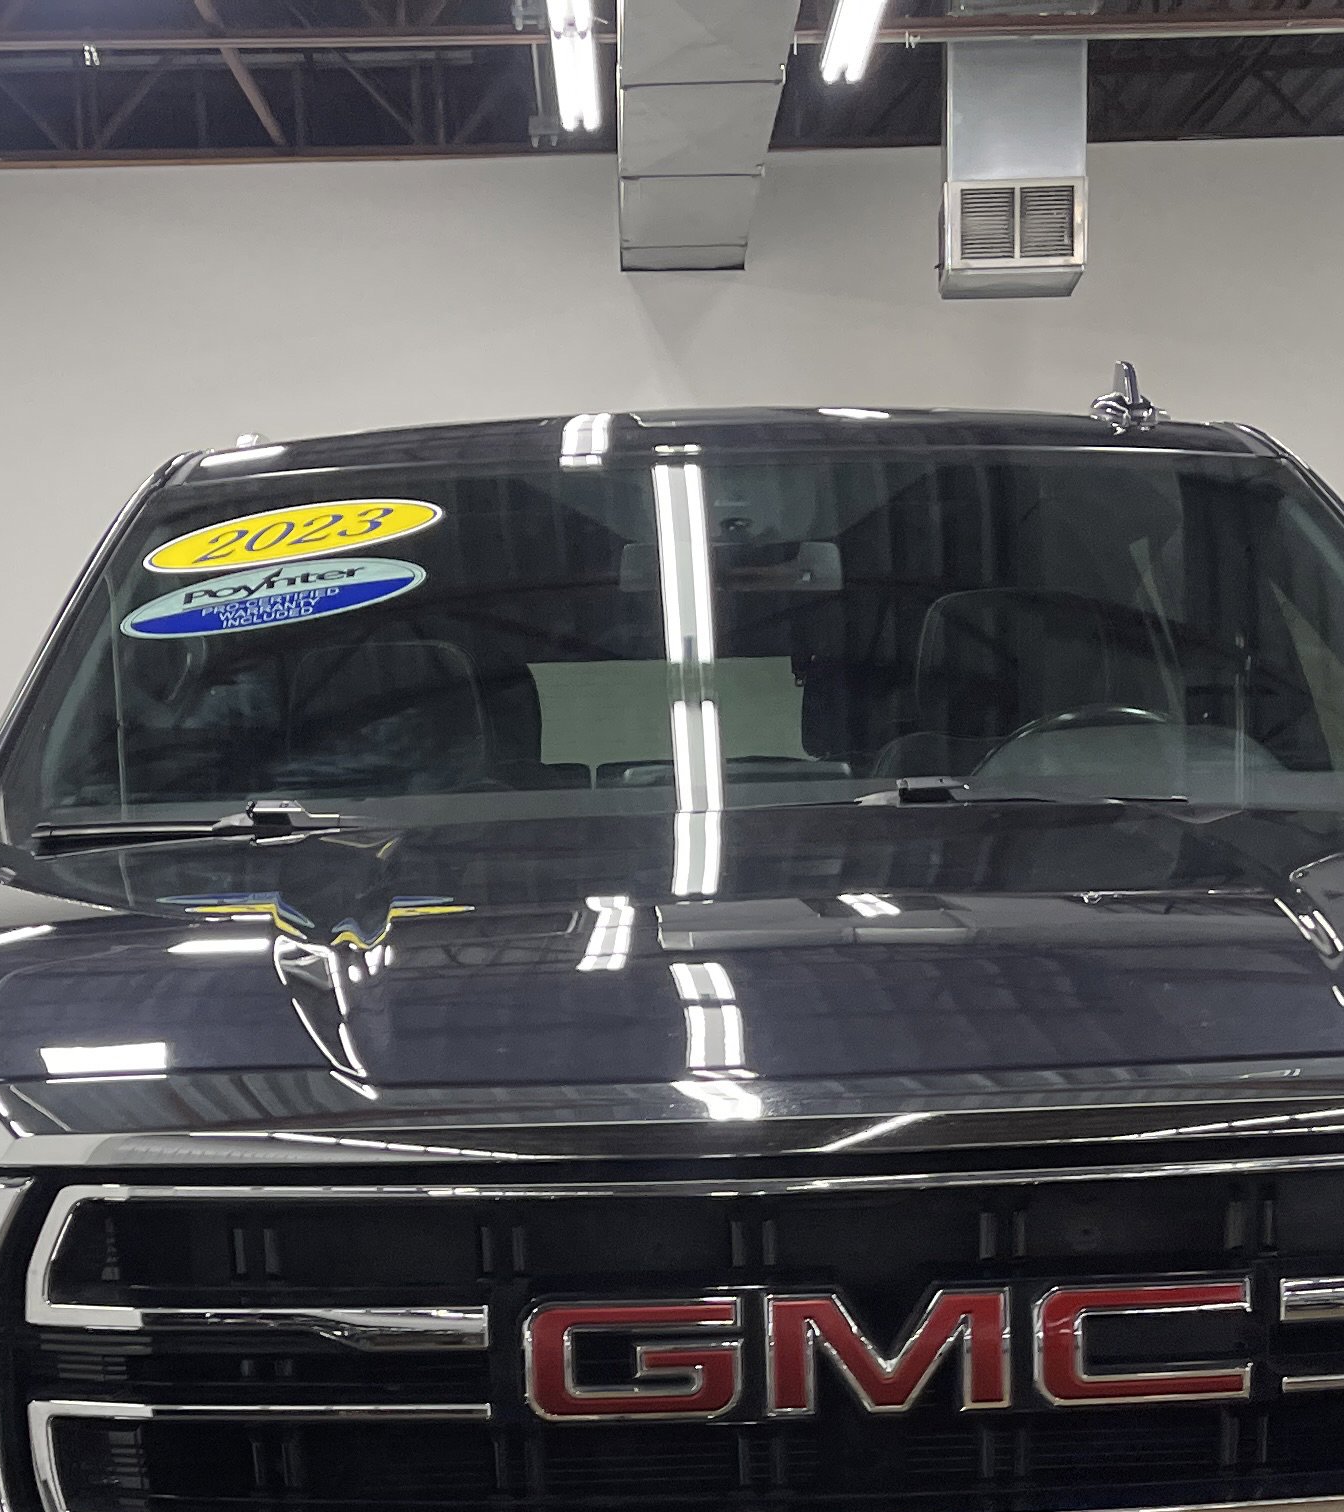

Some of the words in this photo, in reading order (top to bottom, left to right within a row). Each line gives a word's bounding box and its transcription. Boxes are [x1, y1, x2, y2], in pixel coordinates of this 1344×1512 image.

[192, 506, 395, 564] 2023
[182, 566, 365, 605] Poynter
[200, 586, 341, 617] PRO-CERTIFIED
[218, 597, 321, 621] WARRANTY
[222, 606, 314, 629] INCLUDED
[523, 1276, 1252, 1422] GMC
